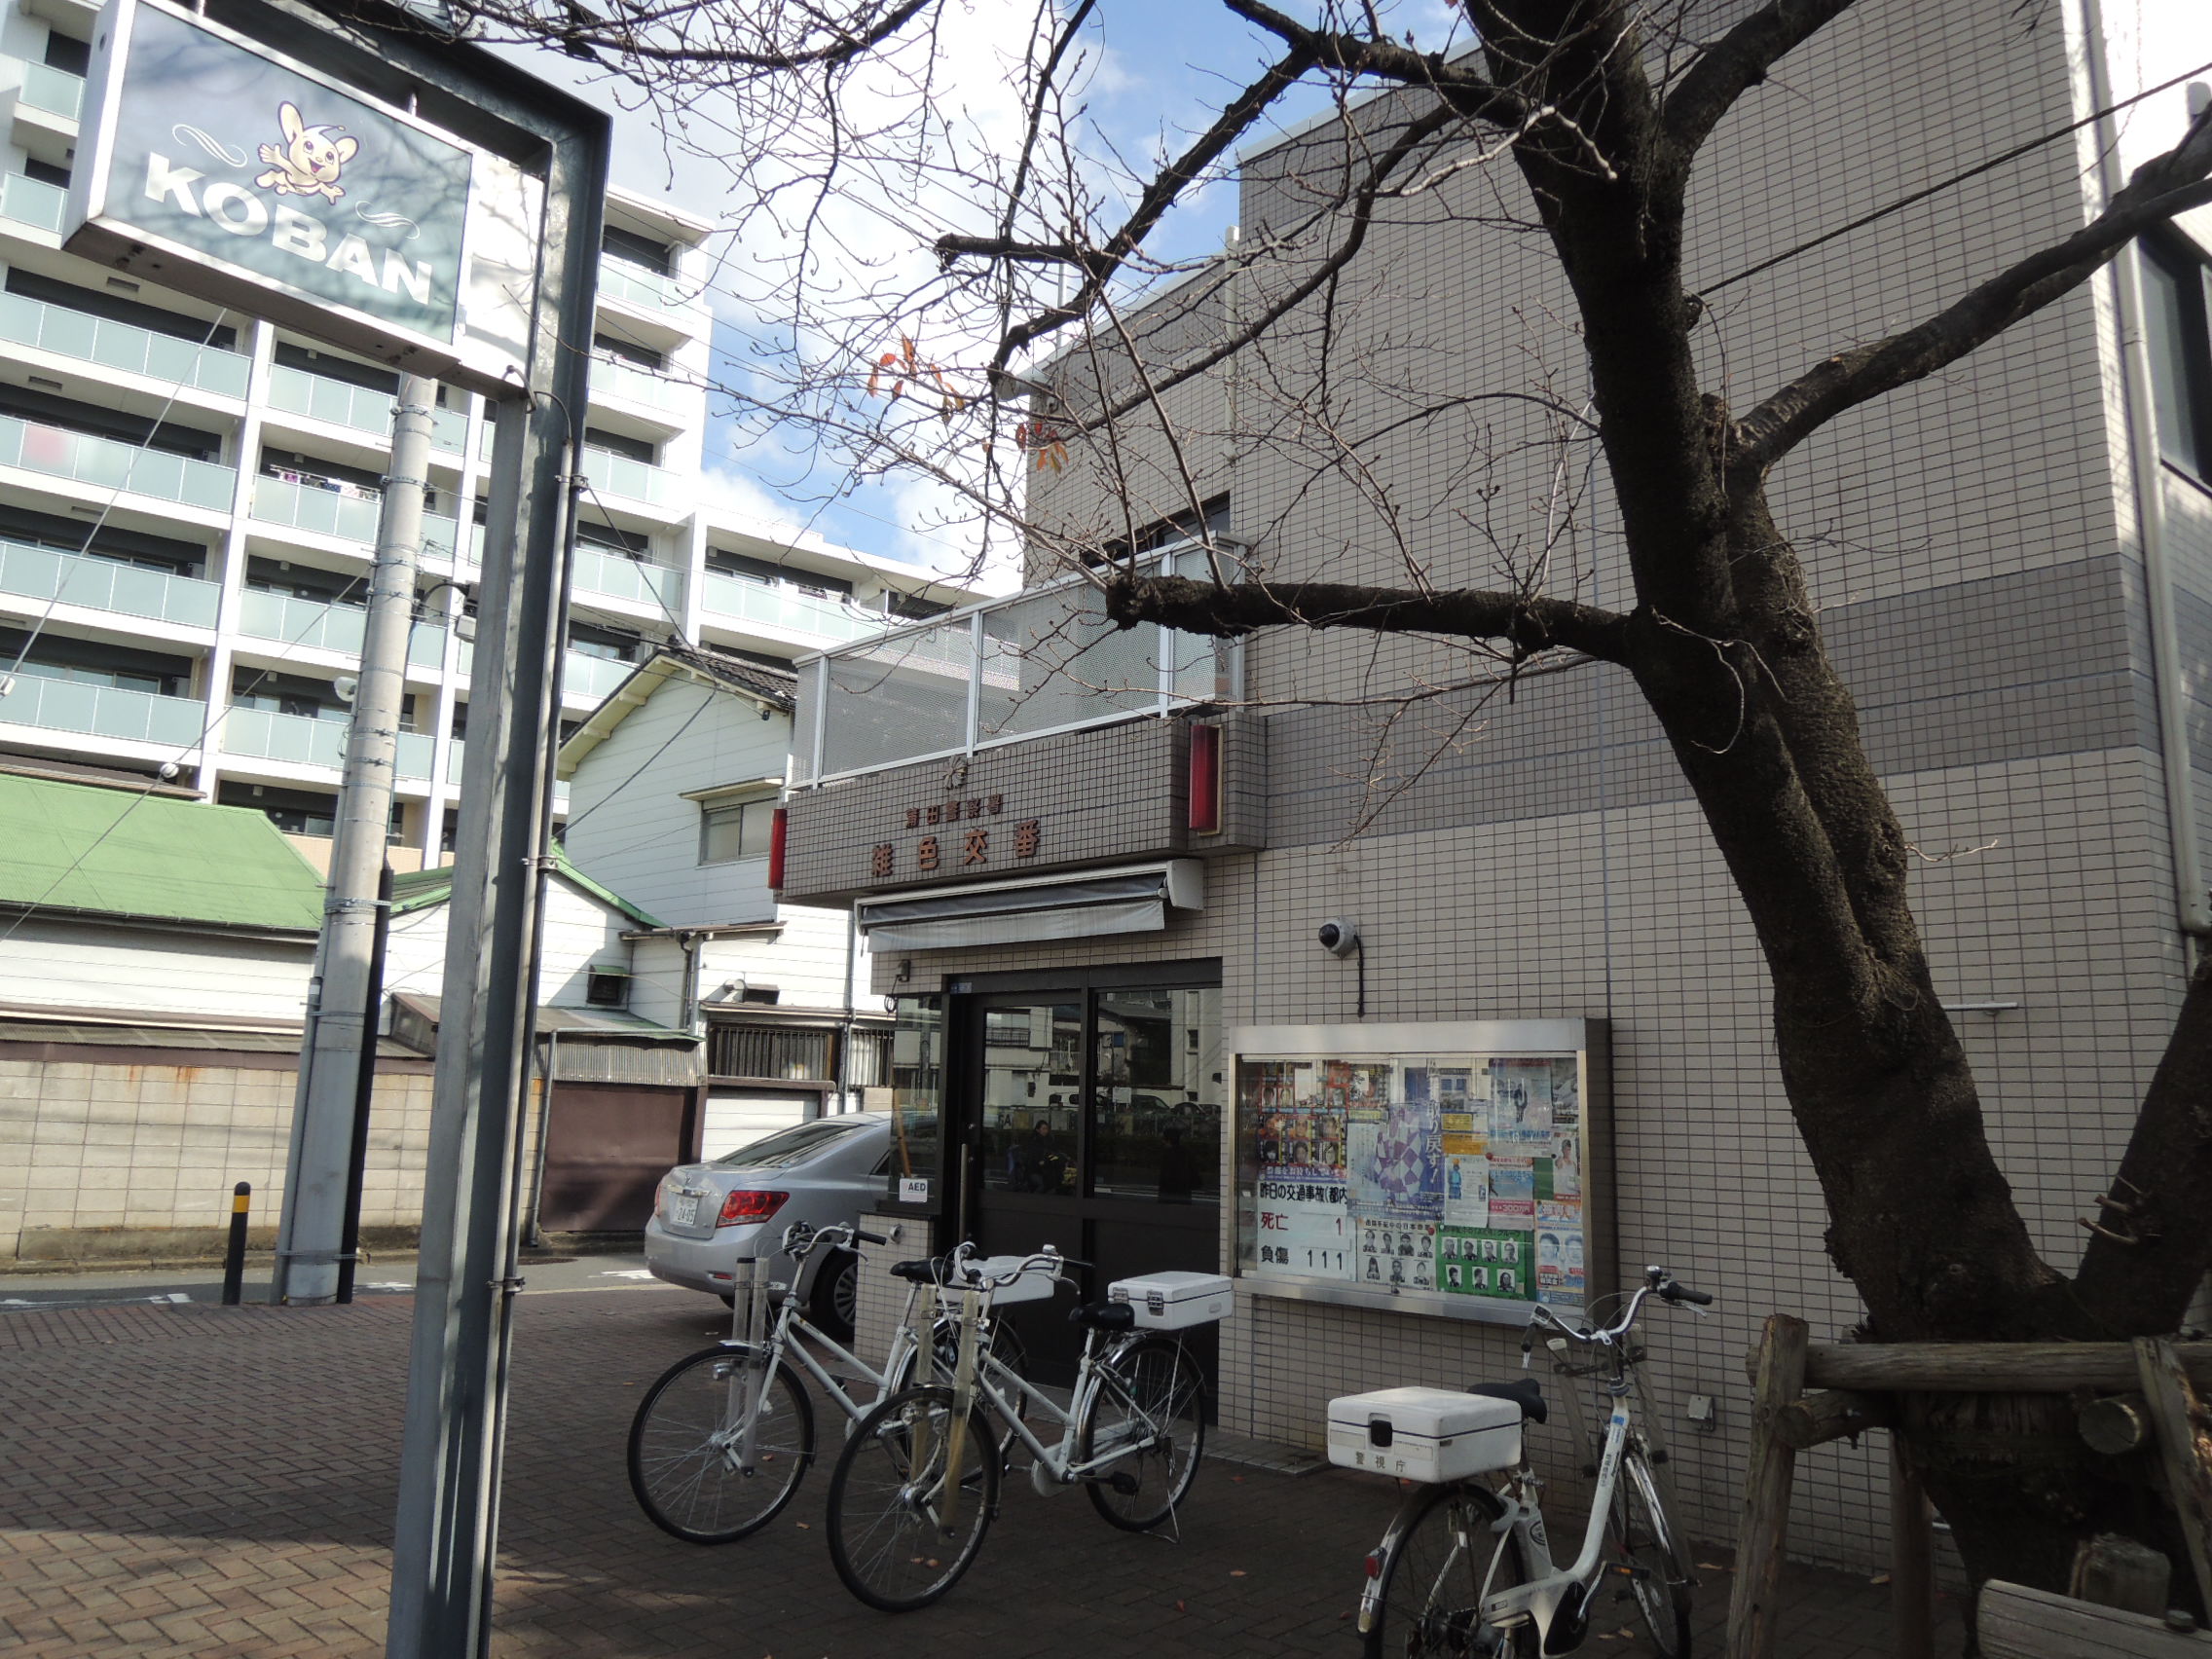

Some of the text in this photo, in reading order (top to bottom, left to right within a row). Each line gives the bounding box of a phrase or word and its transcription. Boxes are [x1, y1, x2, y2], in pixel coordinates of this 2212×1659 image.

[145, 152, 431, 306] KOBAN
[904, 793, 1002, 828] 蒲田警察署
[872, 819, 1039, 877] 雑色交番
[908, 1182, 926, 1192] AED
[1261, 1212, 1342, 1235] 死亡 1
[1261, 1244, 1289, 1265] 負傷
[1355, 1451, 1407, 1472] 警視庁
